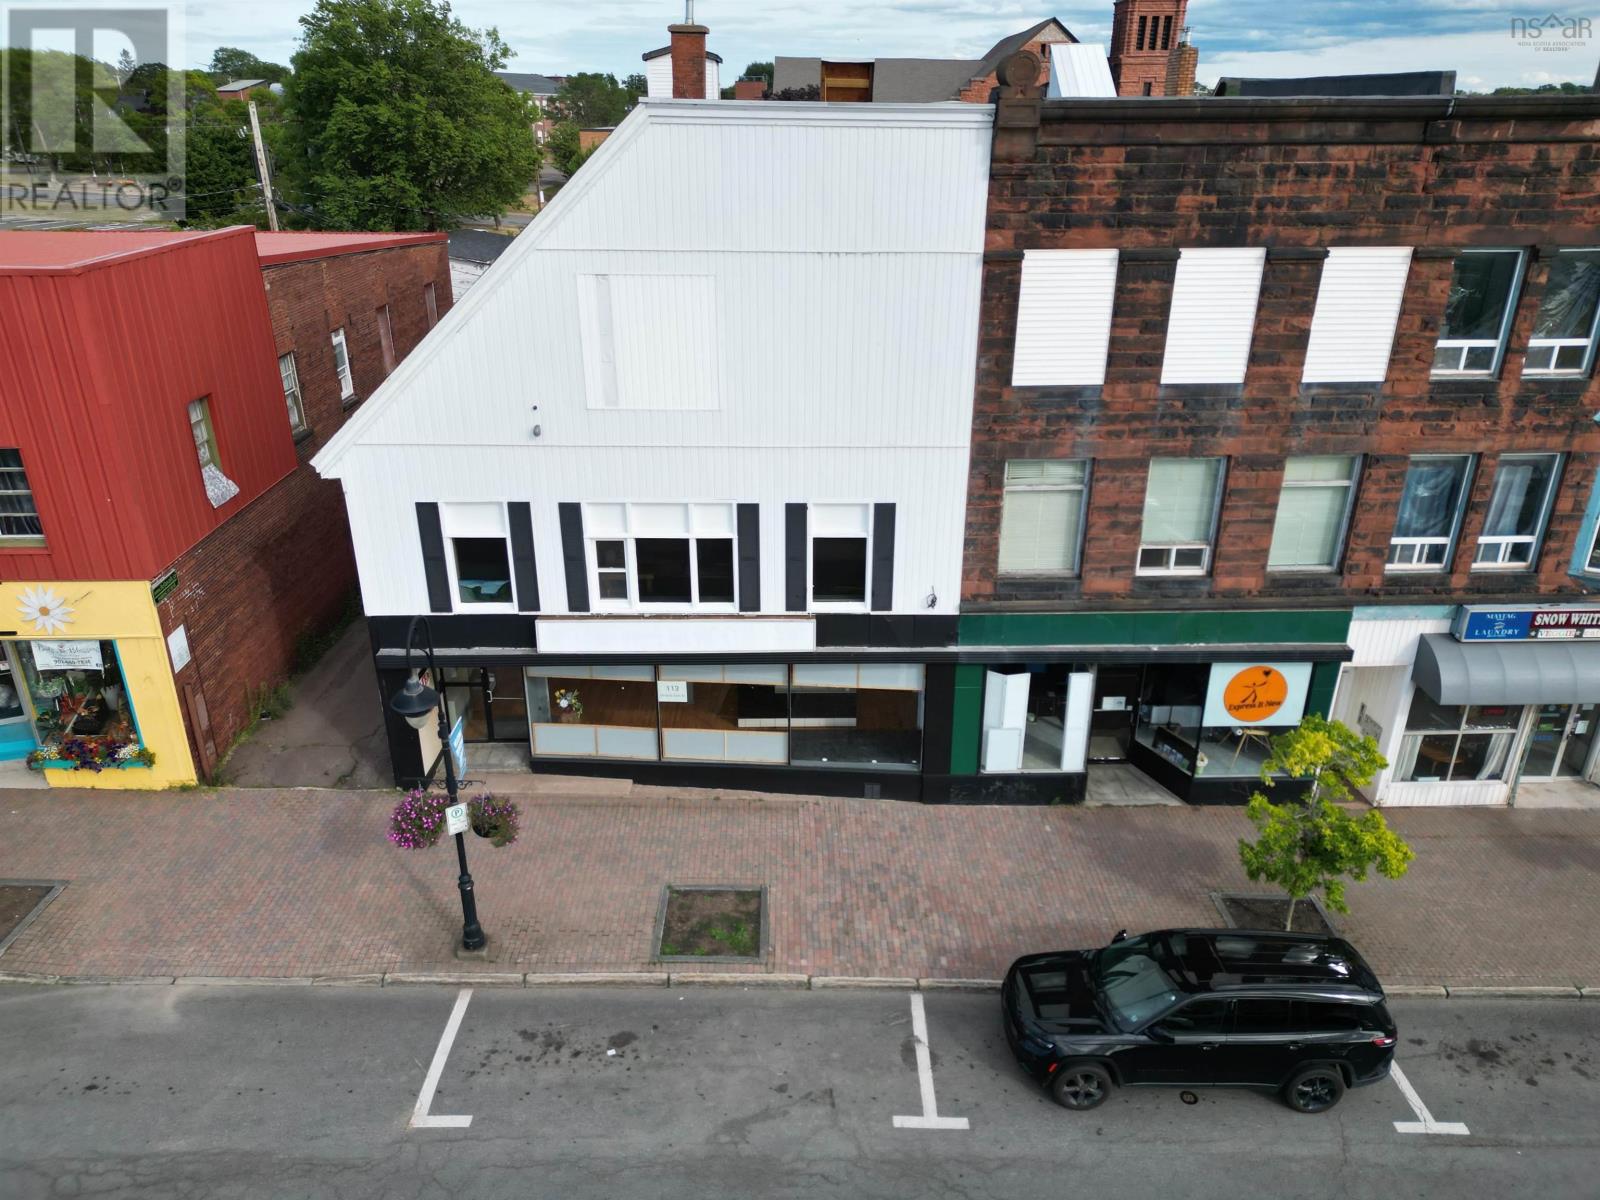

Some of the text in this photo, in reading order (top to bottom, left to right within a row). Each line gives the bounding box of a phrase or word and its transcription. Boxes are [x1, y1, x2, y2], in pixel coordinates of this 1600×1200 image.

[1535, 613, 1600, 625] SNOW WHIT
[1229, 702, 1255, 711] Express
